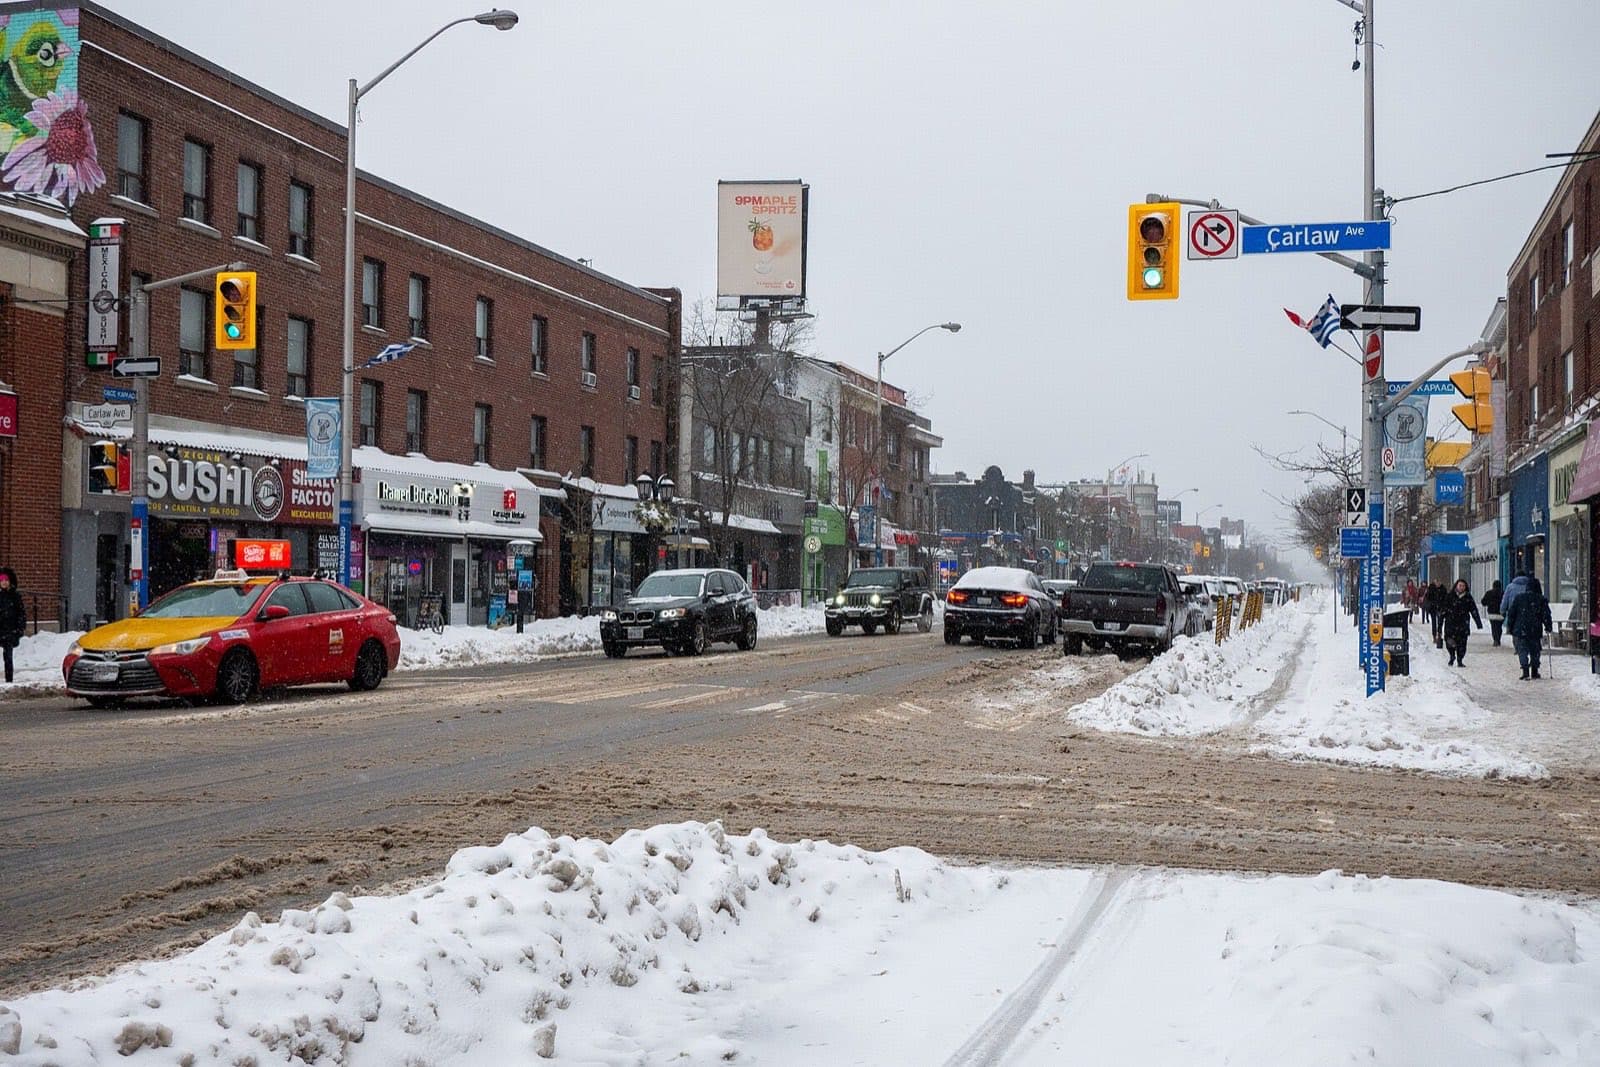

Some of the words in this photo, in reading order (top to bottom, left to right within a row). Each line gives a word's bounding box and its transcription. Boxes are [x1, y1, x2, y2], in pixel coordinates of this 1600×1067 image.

[735, 196, 797, 205] 9PMAPLE
[752, 206, 797, 214] SPRITZ
[1267, 227, 1340, 248] Carlaw
[1345, 225, 1365, 237] Ave
[100, 247, 109, 289] MEXICAN
[88, 408, 112, 418] Carlaw
[113, 408, 126, 418] Ave
[147, 454, 253, 506] SUSHI
[1440, 485, 1463, 493] BMO
[291, 488, 334, 506] FACTO
[172, 503, 201, 513] CANTINA
[291, 510, 315, 519] MEXICAN
[1370, 520, 1381, 596] GREEKTOWN
[1370, 641, 1380, 689] NFORTH
